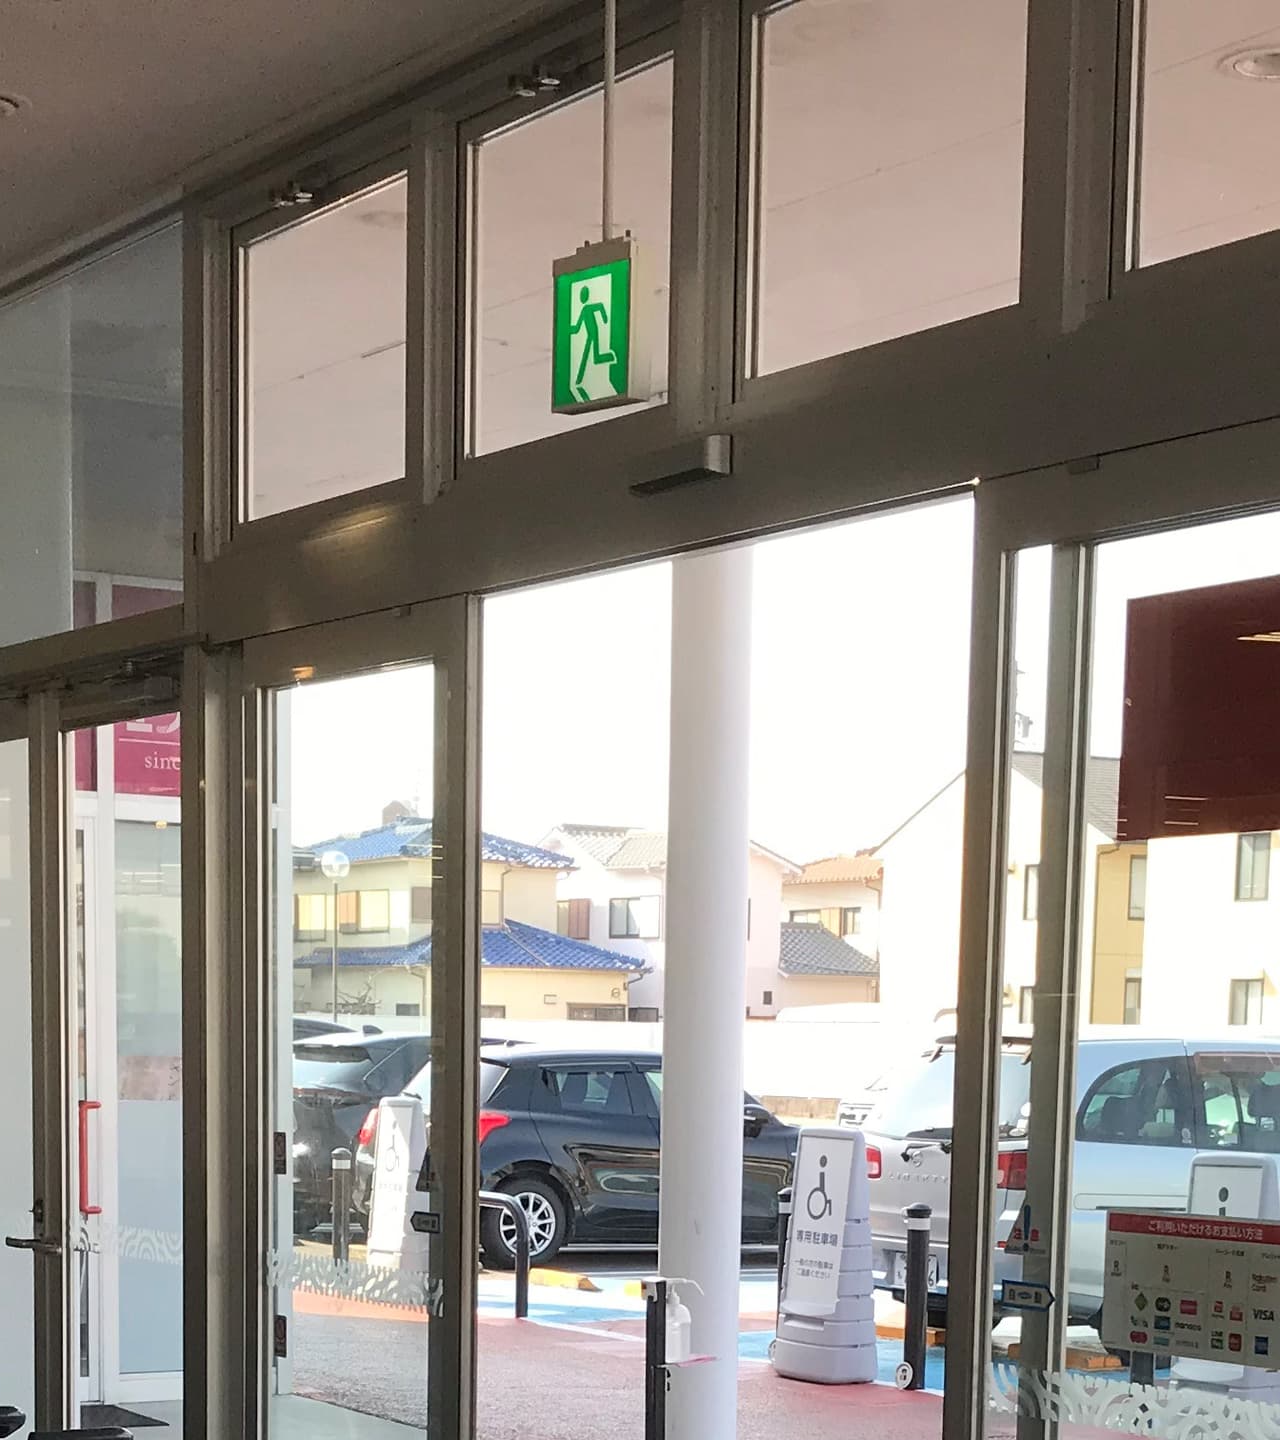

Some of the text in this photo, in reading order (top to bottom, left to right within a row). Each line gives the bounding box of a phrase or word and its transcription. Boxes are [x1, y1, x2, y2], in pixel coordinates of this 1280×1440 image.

[796, 1229, 838, 1247] 専用駐車場
[1252, 1308, 1275, 1321] VISA
